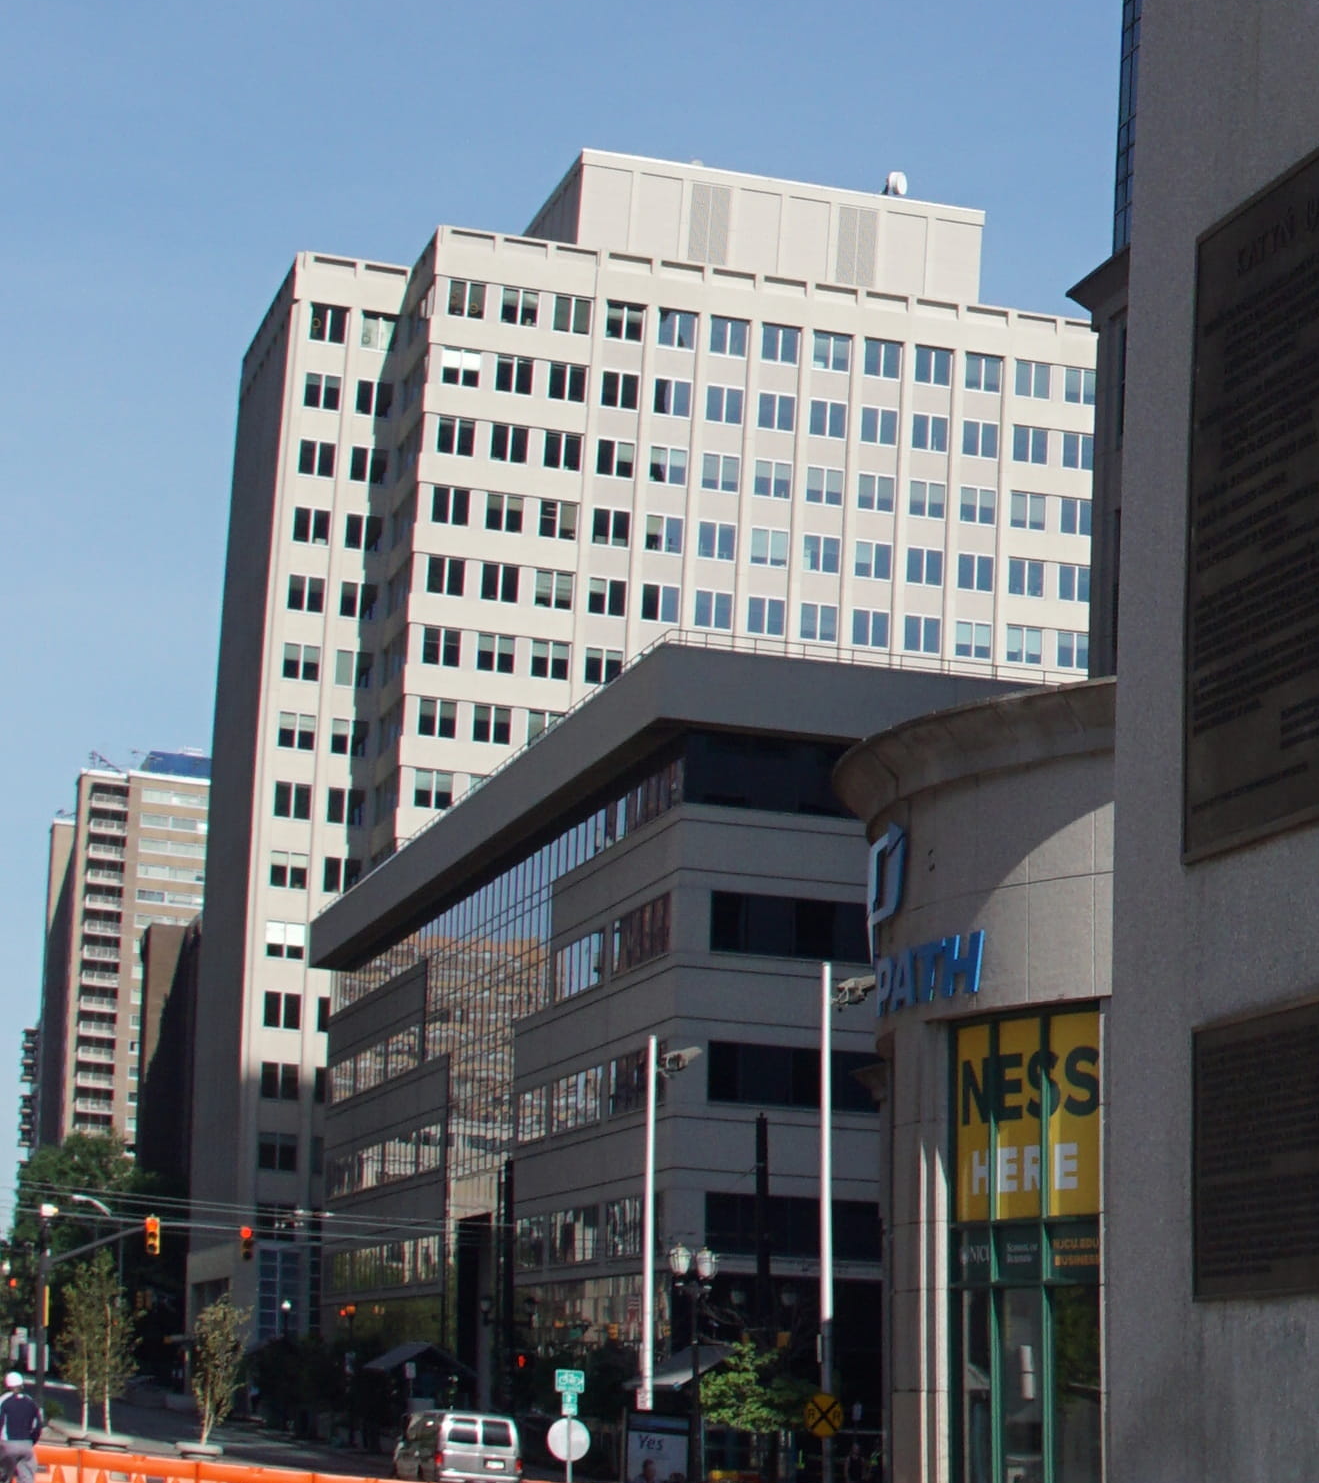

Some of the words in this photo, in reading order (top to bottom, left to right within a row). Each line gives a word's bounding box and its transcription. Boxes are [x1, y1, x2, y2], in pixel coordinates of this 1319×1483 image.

[876, 930, 985, 1018] PATH
[961, 1046, 1100, 1126] NESS
[971, 1142, 1078, 1195] HERE
[638, 1434, 665, 1451] Yes
